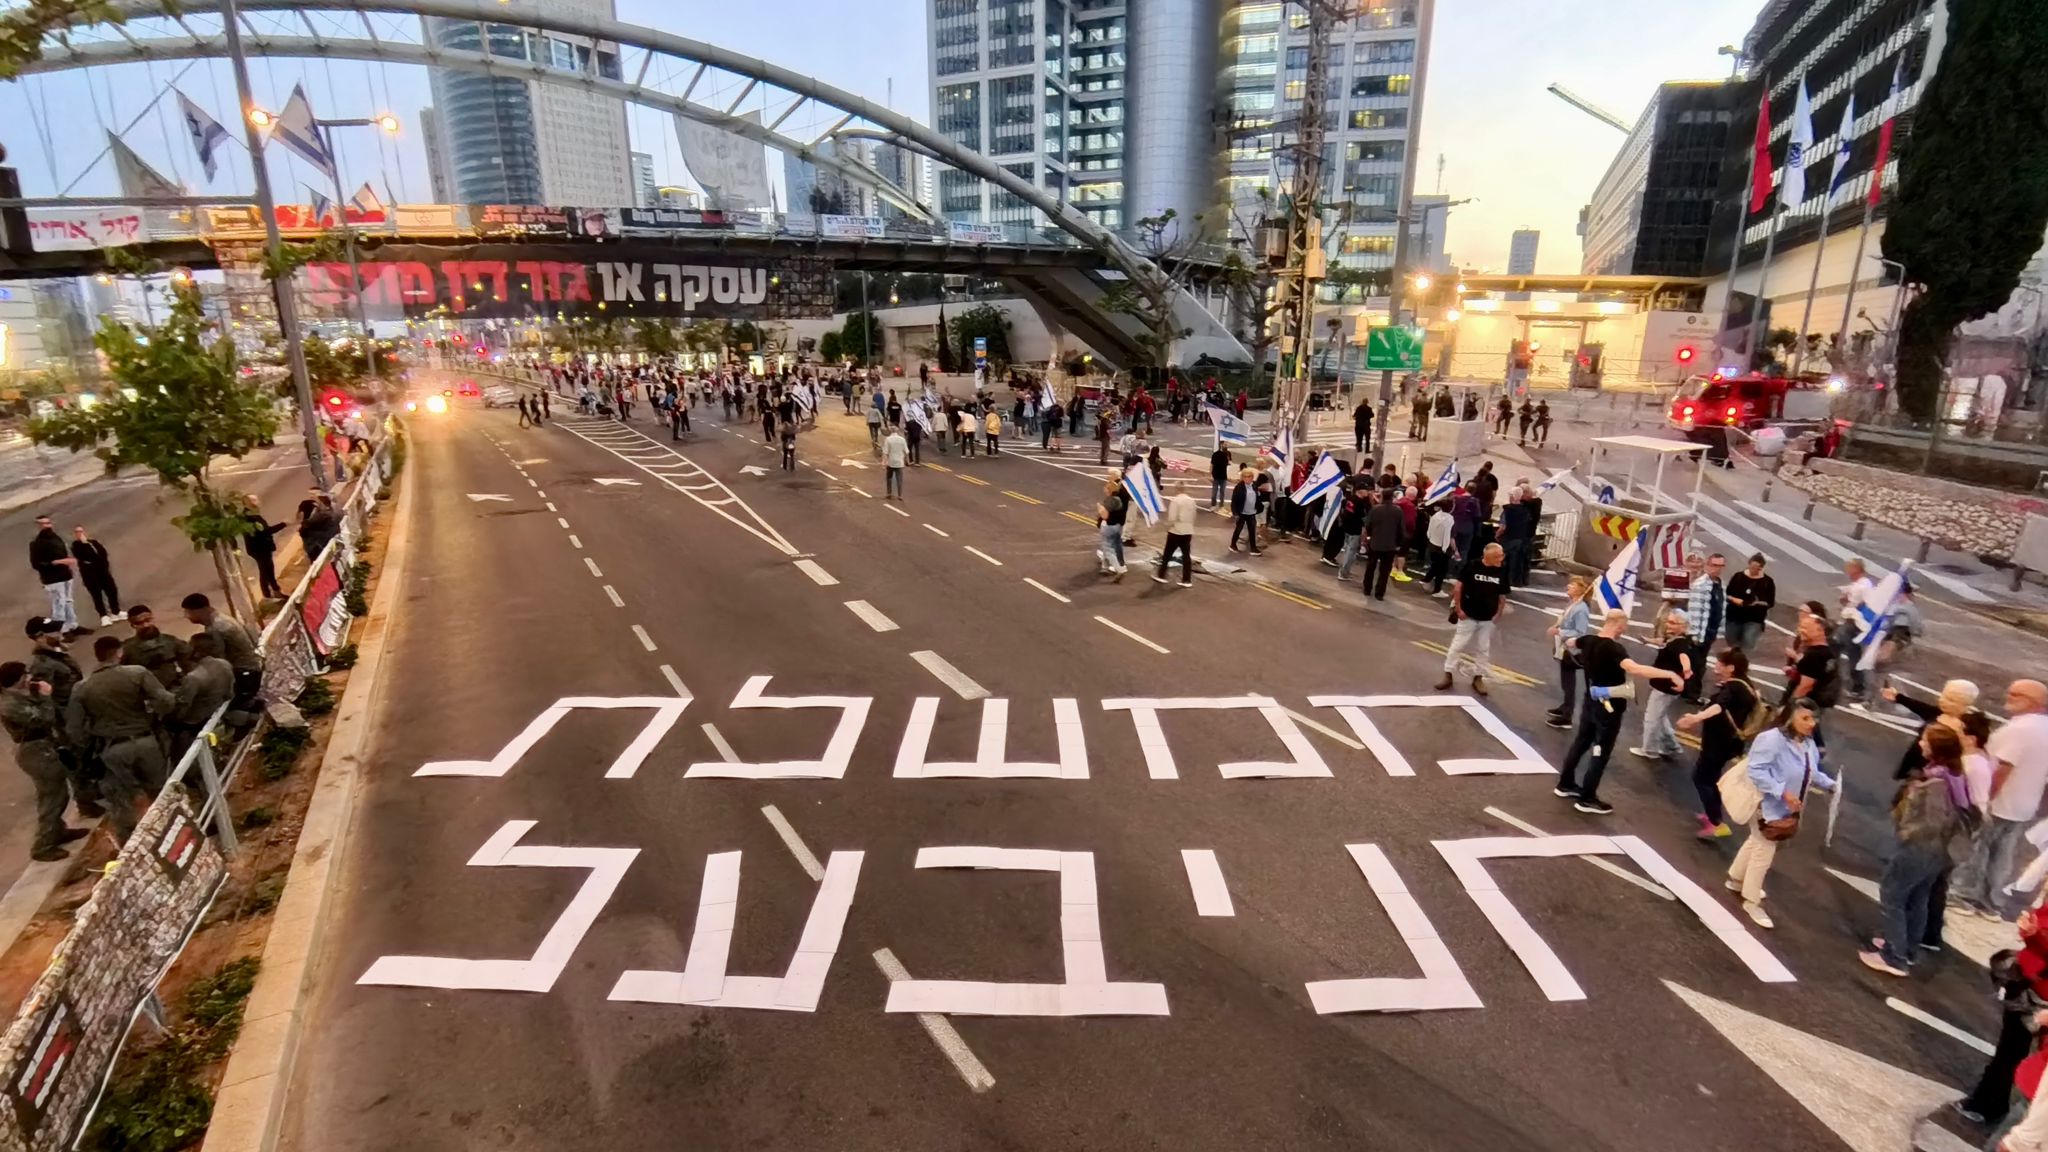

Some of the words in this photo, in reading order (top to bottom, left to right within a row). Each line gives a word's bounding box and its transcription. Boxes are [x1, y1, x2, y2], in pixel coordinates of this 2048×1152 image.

[441, 261, 508, 313] דין
[516, 261, 593, 302] גזר
[597, 262, 645, 302] או
[654, 264, 767, 311] עסקה
[1474, 573, 1500, 585] CELINE
[411, 676, 1558, 780] ממשלת
[355, 819, 1797, 1017] חניבעל
